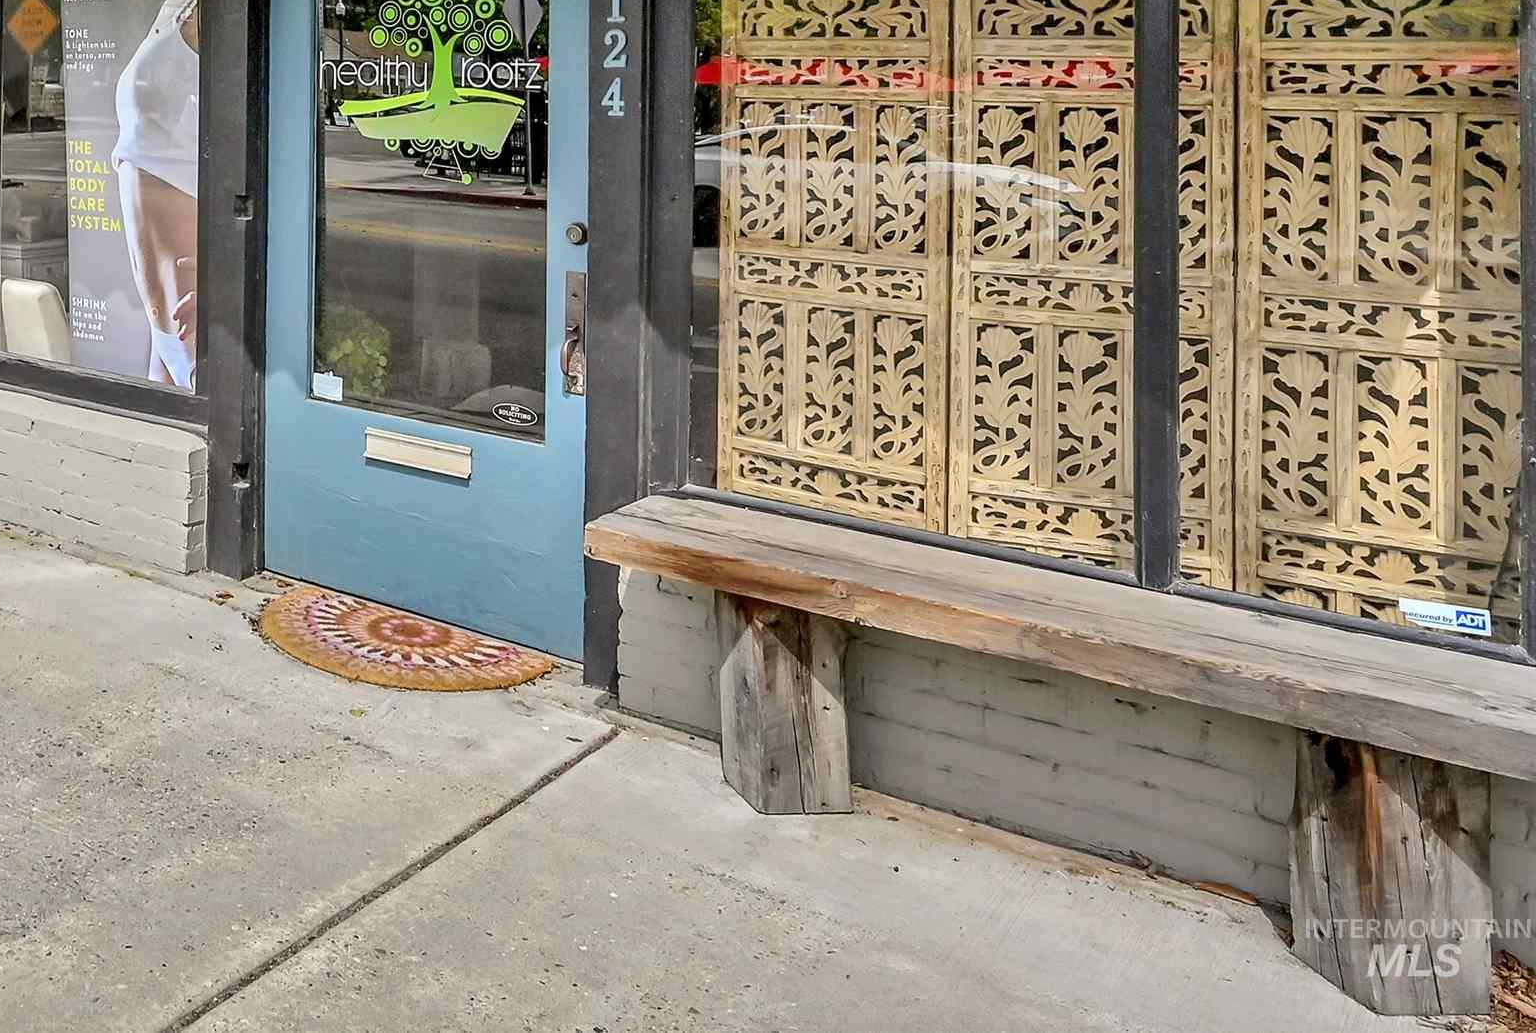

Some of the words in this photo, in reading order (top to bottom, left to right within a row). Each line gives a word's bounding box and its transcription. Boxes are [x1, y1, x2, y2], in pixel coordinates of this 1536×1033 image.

[65, 29, 88, 39] TONE
[72, 41, 99, 52] tighten
[100, 39, 115, 48] skin
[319, 50, 428, 93] healthy
[461, 55, 542, 89] rootz
[68, 140, 93, 155] THE
[69, 158, 112, 175] TOTAL
[70, 177, 106, 193] BODY
[70, 196, 105, 212] CARE
[70, 214, 122, 232] SYSTEM
[72, 297, 107, 312] SHRINK
[1406, 610, 1441, 621] ecured
[1442, 616, 1454, 624] by
[1457, 613, 1485, 628] ADT
